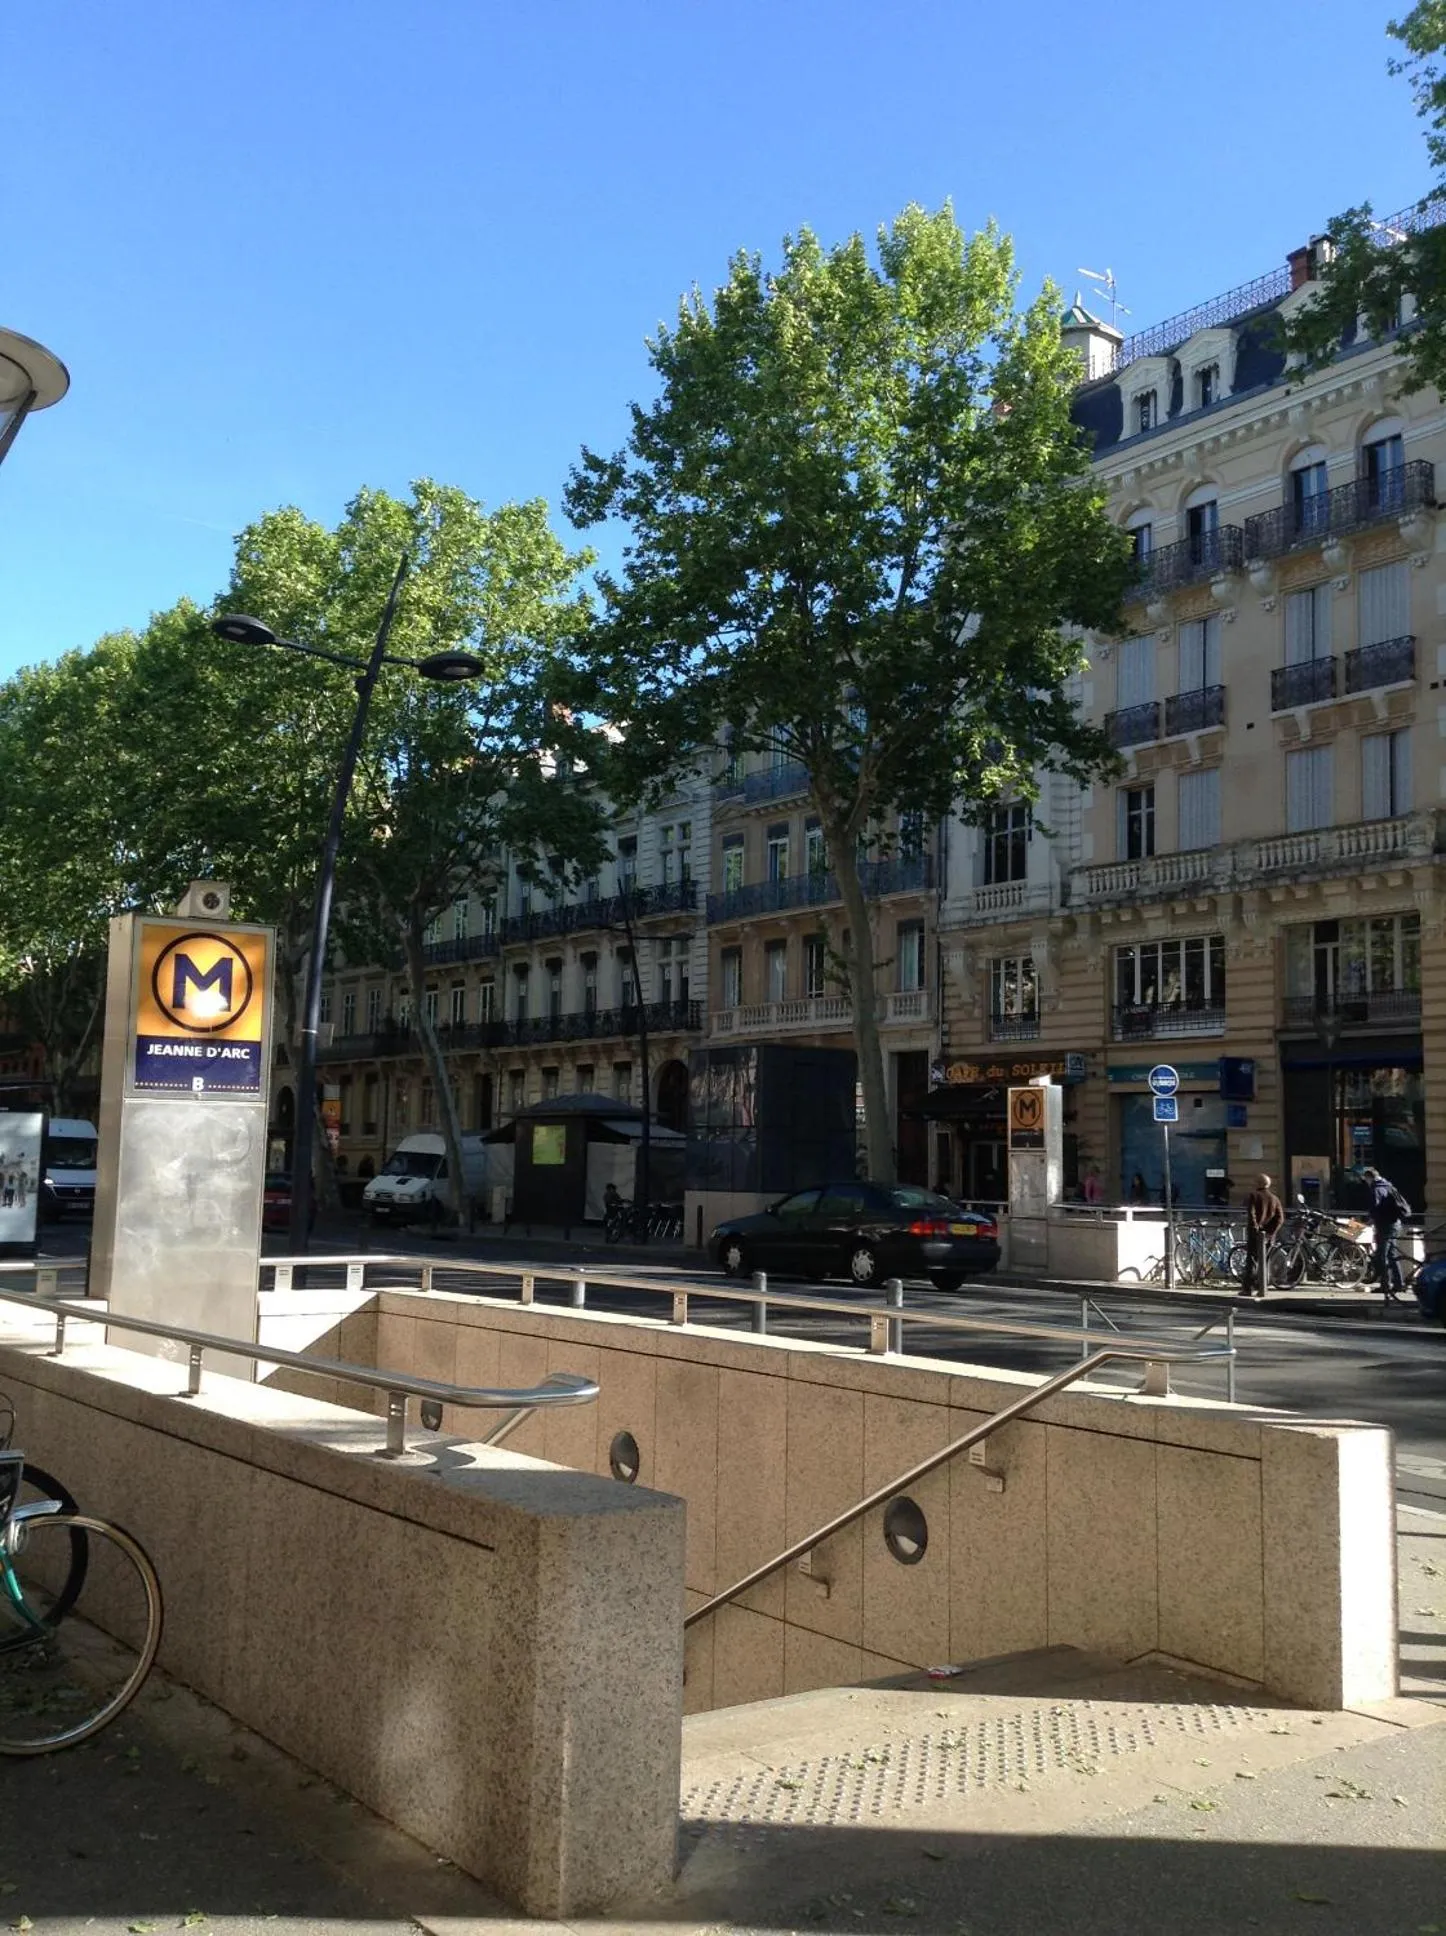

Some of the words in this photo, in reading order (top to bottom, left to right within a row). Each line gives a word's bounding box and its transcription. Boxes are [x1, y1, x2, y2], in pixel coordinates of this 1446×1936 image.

[173, 955, 233, 1011] M
[147, 1044, 202, 1057] JEANNE
[207, 1047, 250, 1059] D'ARC
[986, 1065, 1005, 1077] du
[1012, 1062, 1065, 1076] SOLEIL
[192, 1077, 204, 1091] B
[1019, 1098, 1036, 1120] M
